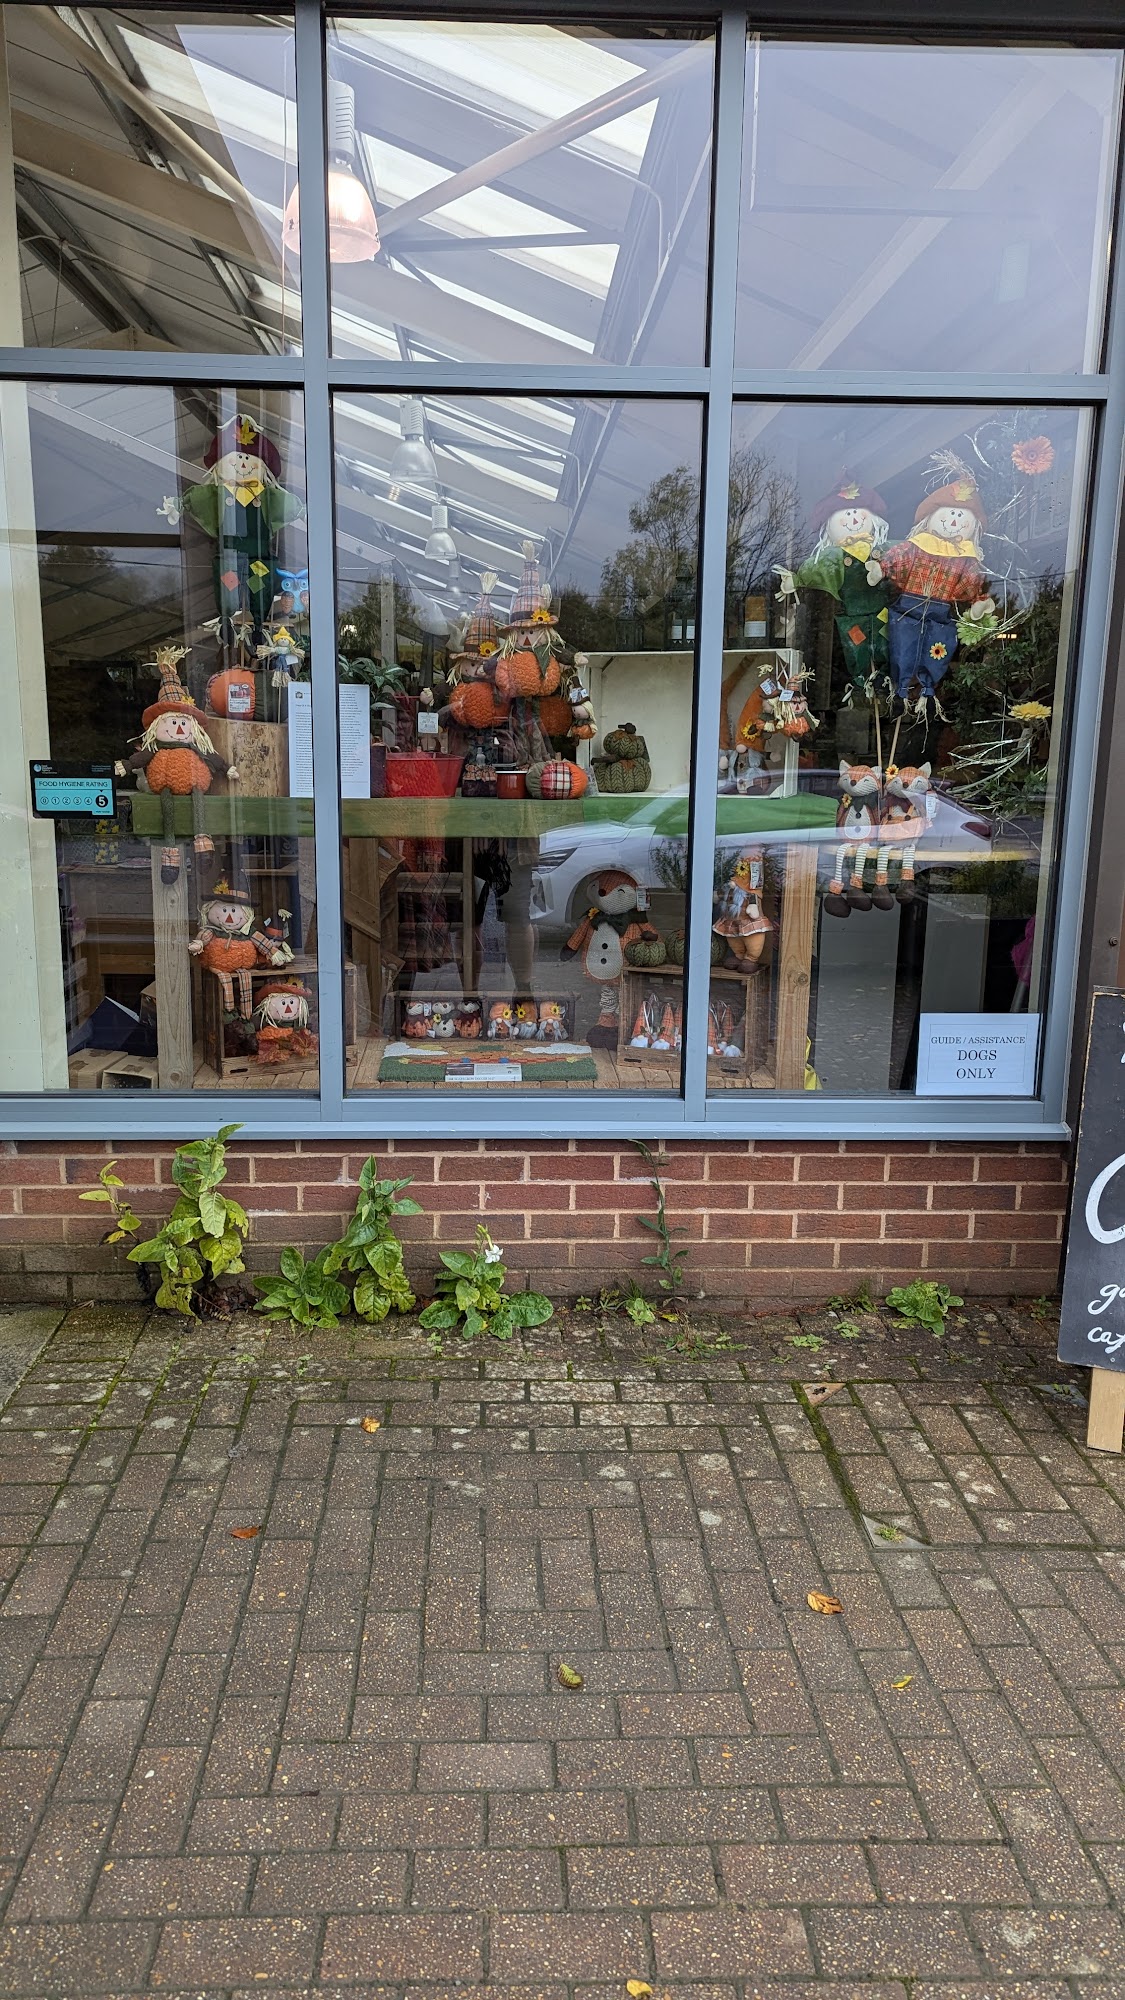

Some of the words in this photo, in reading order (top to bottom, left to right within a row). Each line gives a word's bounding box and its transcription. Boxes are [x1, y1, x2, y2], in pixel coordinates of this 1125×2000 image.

[98, 796, 106, 806] 5
[931, 1036, 962, 1044] GUIDE
[968, 1036, 1026, 1044] ASSISTANCE
[957, 1049, 997, 1061] DOGS
[956, 1067, 997, 1079] ONLY
